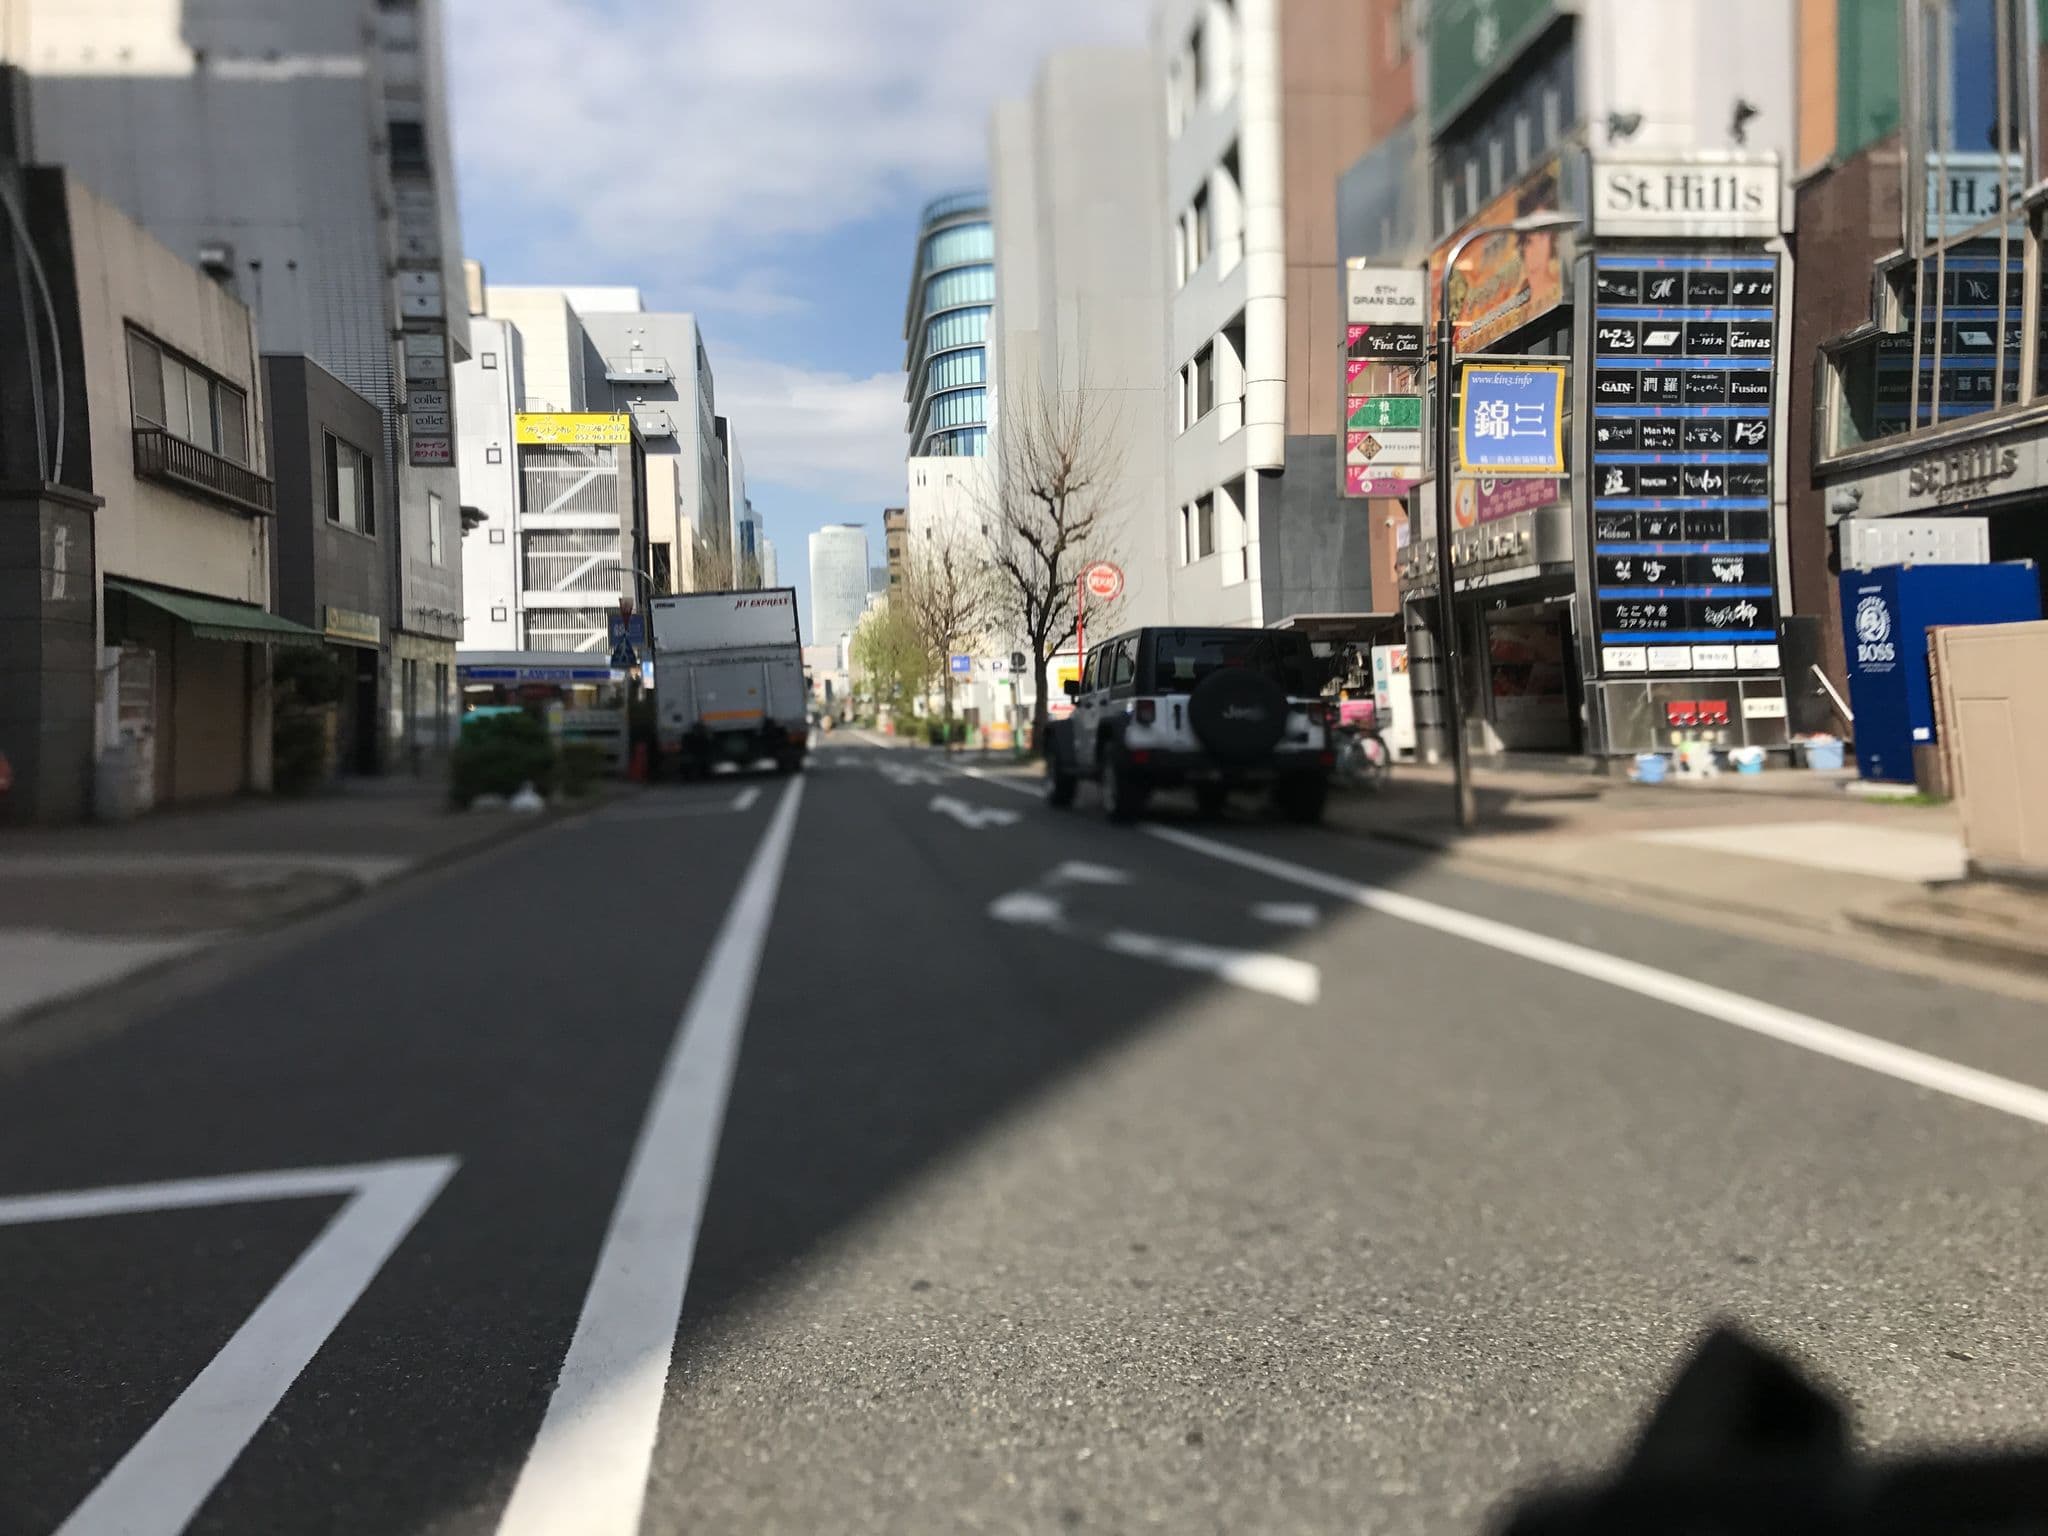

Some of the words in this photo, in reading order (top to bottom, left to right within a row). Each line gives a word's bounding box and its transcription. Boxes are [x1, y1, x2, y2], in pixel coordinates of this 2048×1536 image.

[1608, 174, 1763, 212] St.Hills
[1348, 328, 1363, 338] 5F
[1371, 339, 1394, 351] First
[1396, 340, 1418, 352] Class
[1730, 335, 1771, 348] Canvas
[1348, 364, 1362, 374] 4F
[1731, 382, 1768, 394] Fusion
[414, 394, 442, 404] collet
[1348, 399, 1362, 409] 3F
[415, 416, 444, 425] collet
[1474, 400, 1547, 440] 錦三
[1348, 434, 1361, 443] 2F
[1857, 642, 1896, 662] BOSS
